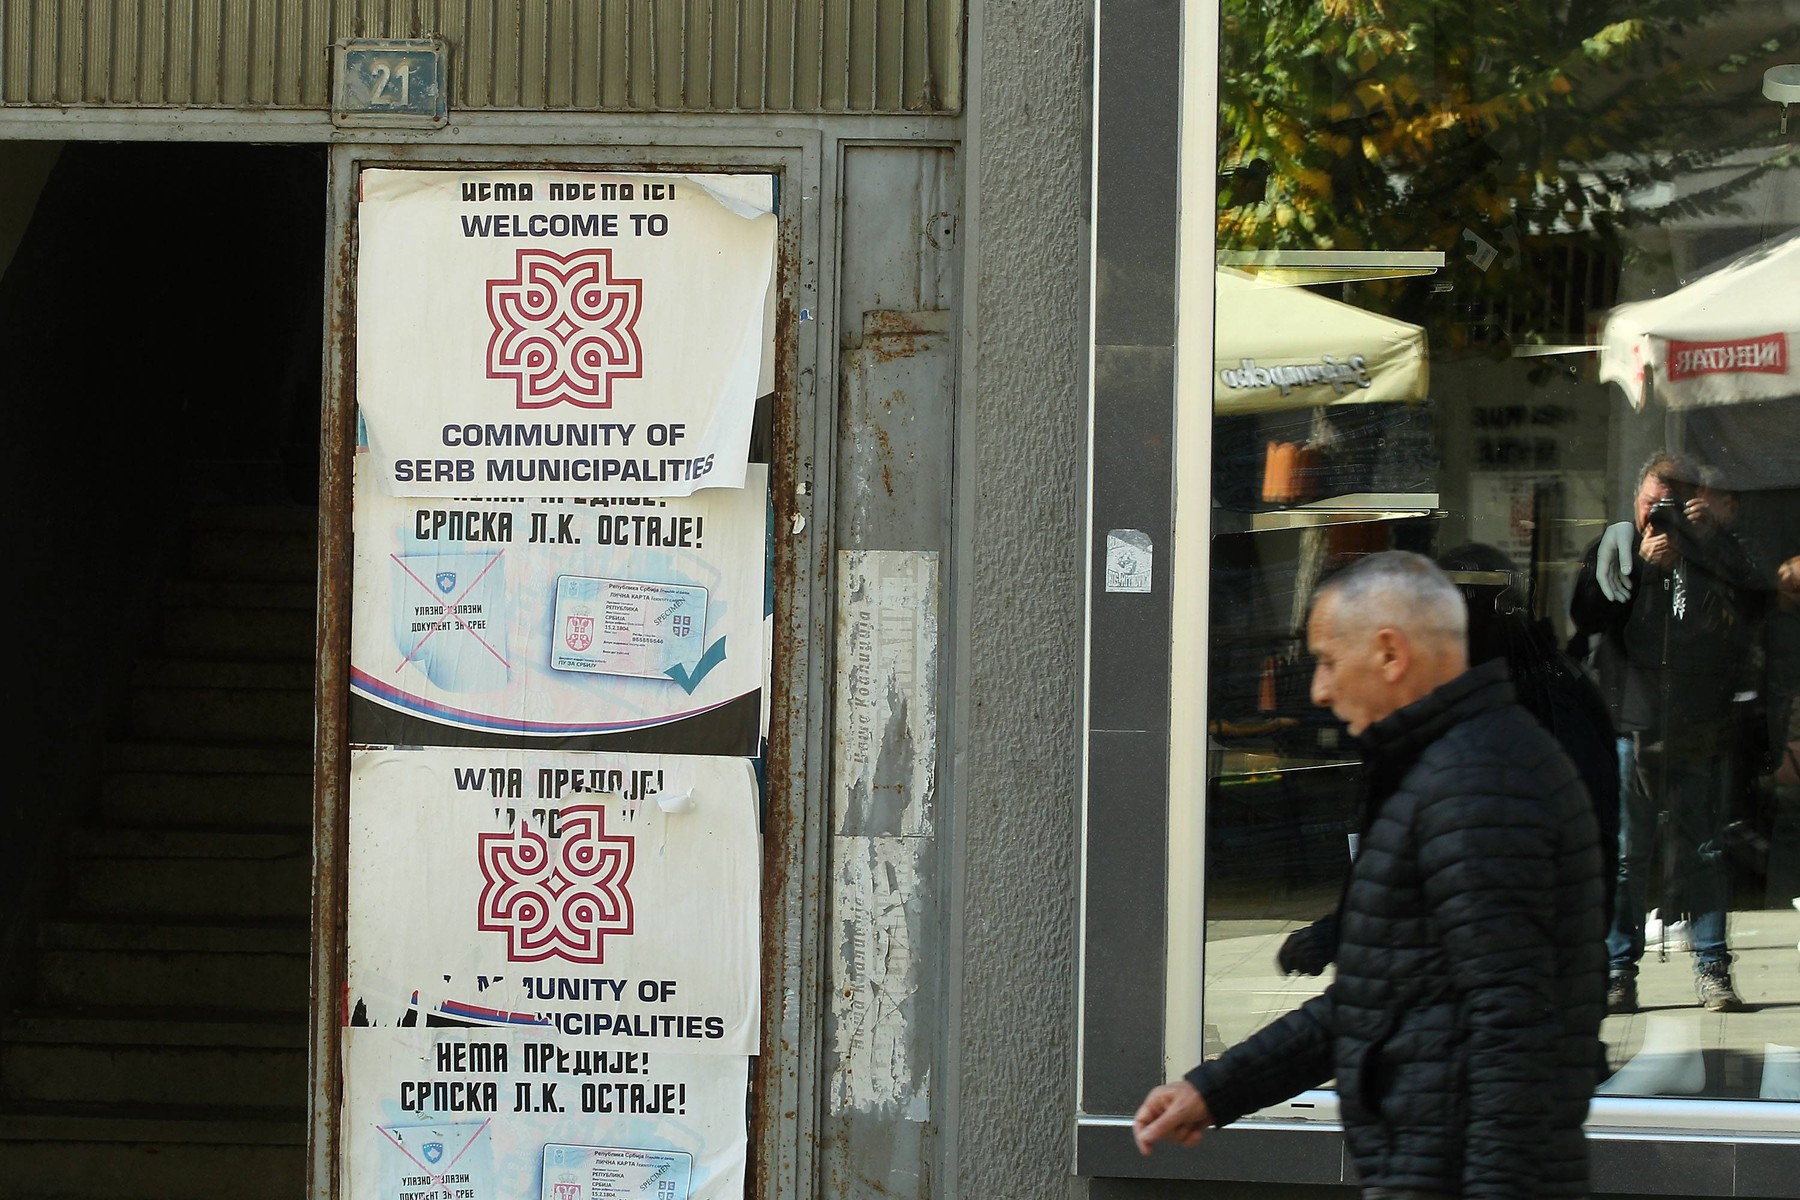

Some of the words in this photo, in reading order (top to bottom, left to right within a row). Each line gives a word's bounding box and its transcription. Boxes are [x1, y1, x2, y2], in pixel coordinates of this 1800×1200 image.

[371, 64, 409, 106] 21
[461, 214, 619, 237] WELCOME
[630, 214, 669, 236] TO
[443, 424, 636, 446] COMMUNITY
[646, 424, 685, 446] OF
[395, 459, 475, 482] SERB
[486, 453, 715, 482] MUNICIPALITIES
[416, 510, 512, 542] СРПСКА
[529, 513, 581, 544] Л.К.
[598, 515, 703, 549] ОСТАЈЕ!
[654, 597, 687, 626] SPECIMEN
[639, 980, 677, 1002] OF
[537, 1012, 725, 1039] ICIPALITIES
[436, 1042, 508, 1073] НЕМА
[400, 1081, 497, 1112] СРПСКА
[513, 1082, 565, 1113] Л.К.
[581, 1083, 686, 1115] ОСТАЈЕ!
[402, 1174, 470, 1186] УЛАЗНО-ЗЛАЗНИ
[640, 1163, 671, 1191] SPECIMEN
